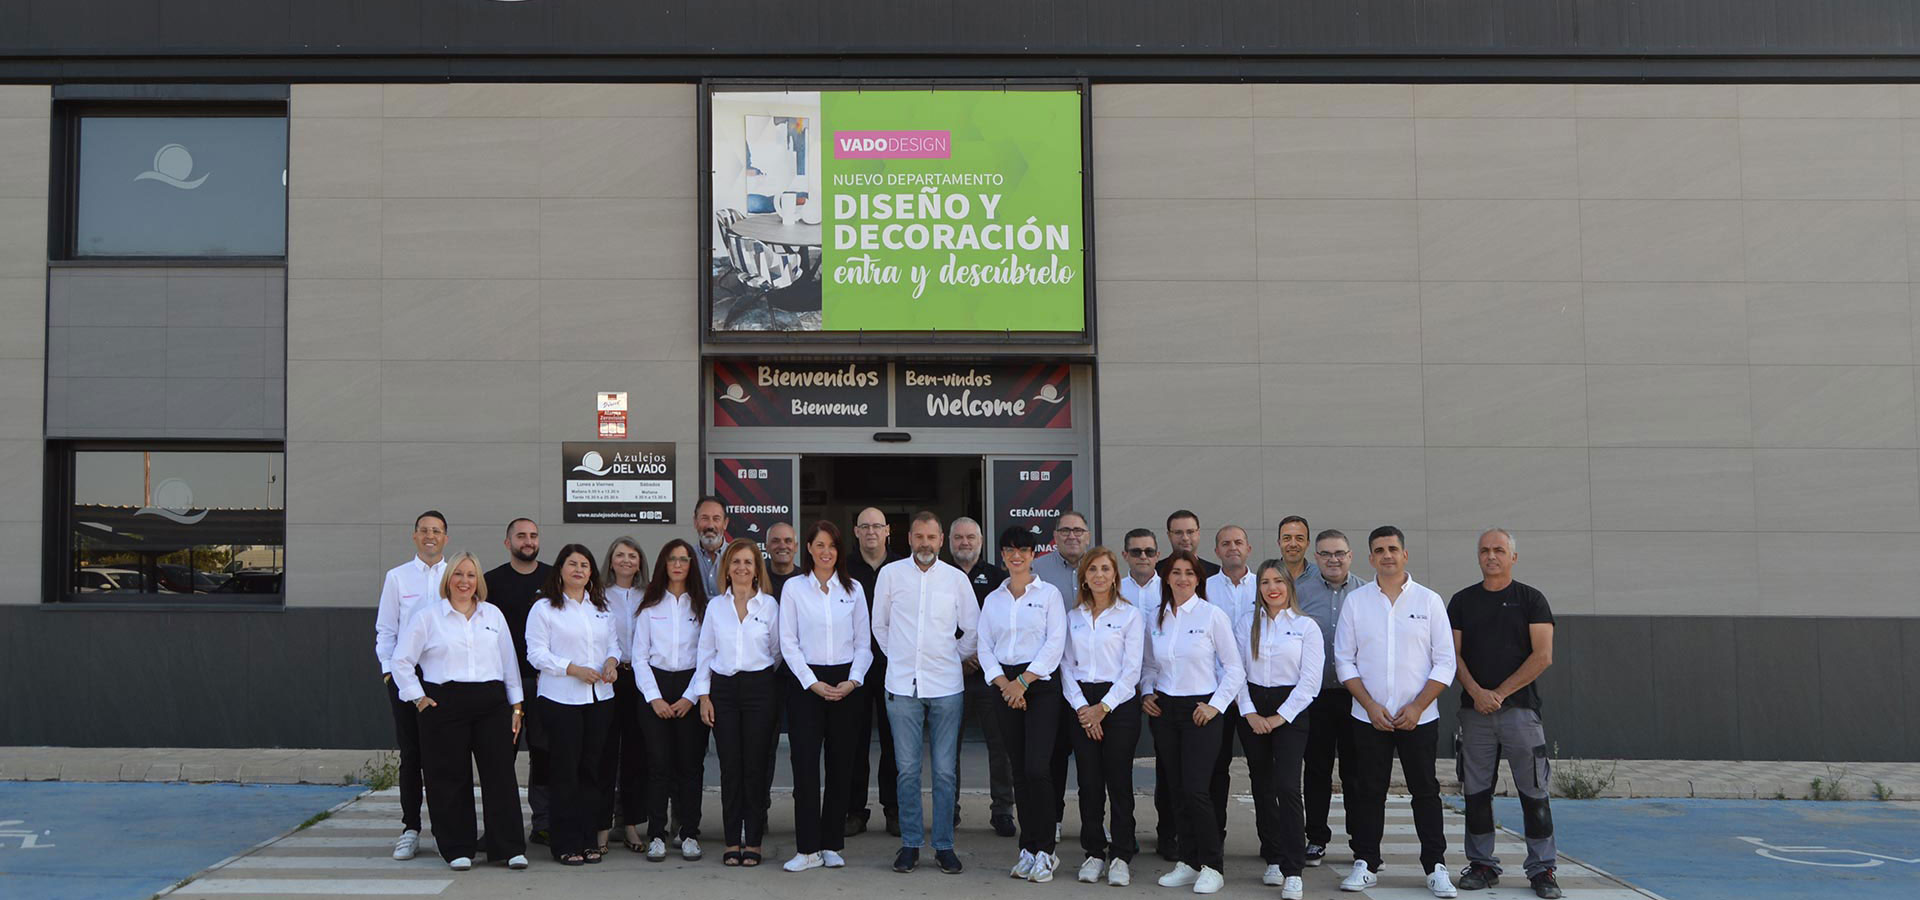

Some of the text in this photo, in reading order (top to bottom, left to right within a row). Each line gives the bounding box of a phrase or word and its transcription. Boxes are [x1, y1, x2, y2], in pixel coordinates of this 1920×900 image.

[840, 138, 946, 152] VADODESIGN
[833, 174, 1004, 186] NUEVO DEPARTAMENTO
[834, 187, 1001, 219] DISEÑO Y
[834, 216, 1070, 250] DECORACIÓN
[834, 253, 1075, 299] entra y descúbrelo
[758, 364, 879, 387] Bienvenidos
[905, 369, 992, 387] Bem-vindos
[791, 398, 868, 416] Bienvenue
[926, 389, 1026, 417] Welcome
[613, 452, 666, 465] Azulejos
[613, 464, 667, 474] DEL VADO
[726, 505, 789, 514] TERIORISMO
[1010, 507, 1060, 517] CERÁMICA
